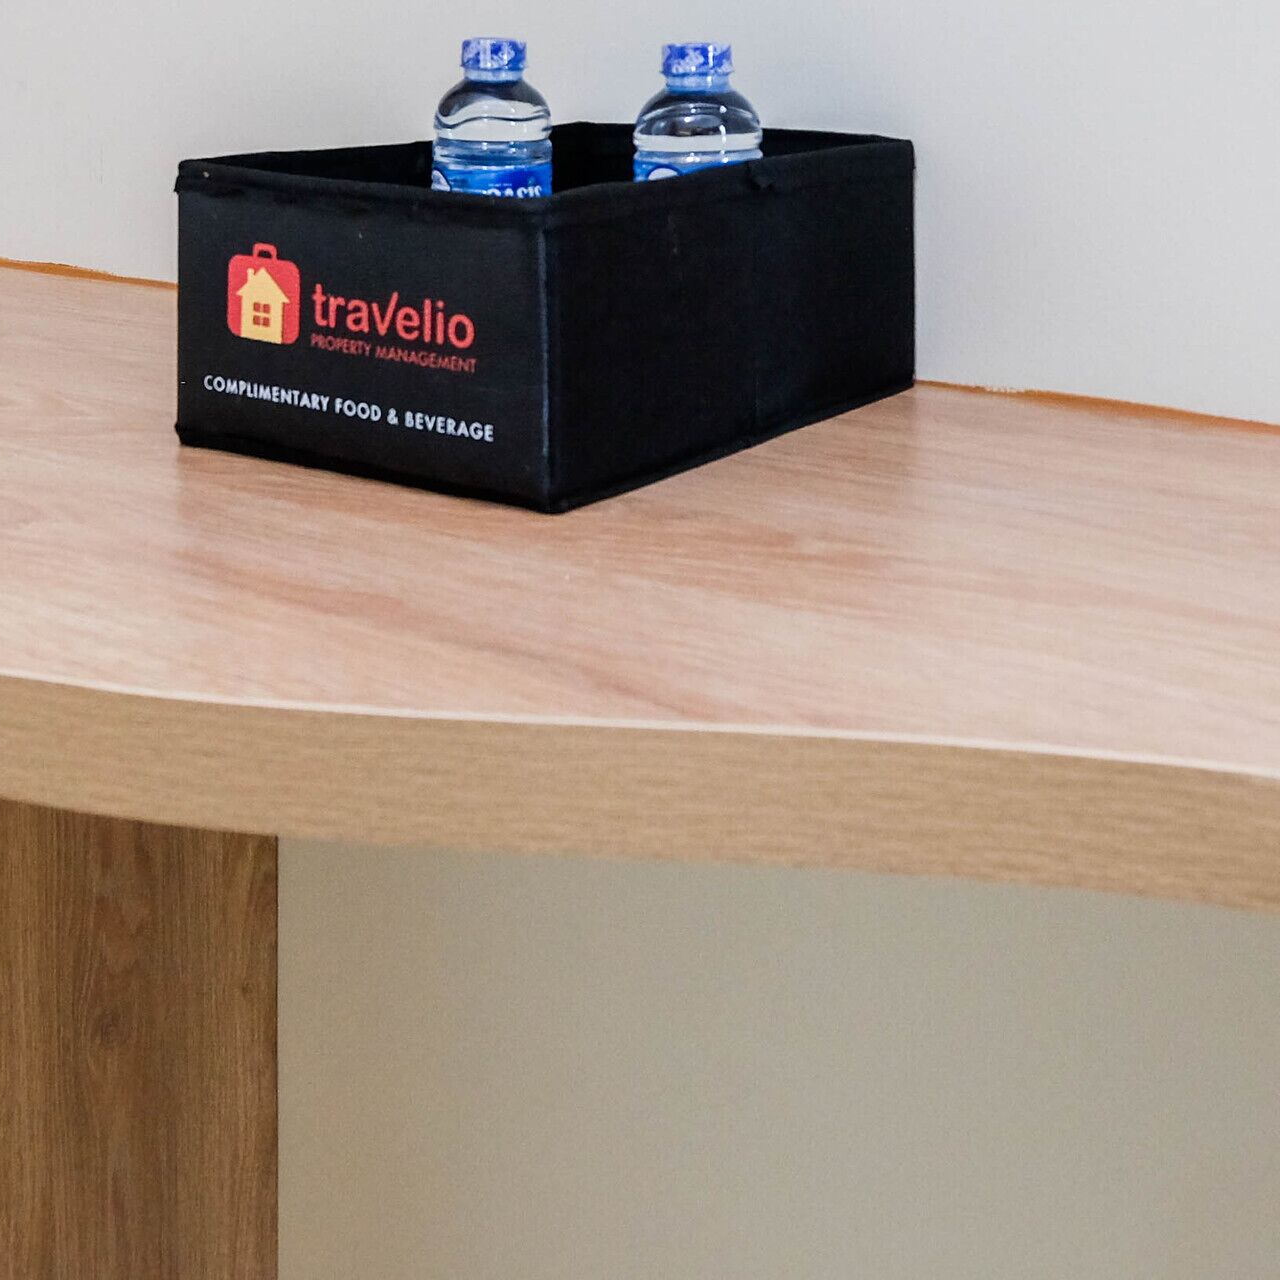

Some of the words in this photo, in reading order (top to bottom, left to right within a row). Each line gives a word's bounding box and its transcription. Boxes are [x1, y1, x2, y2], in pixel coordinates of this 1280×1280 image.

[312, 283, 475, 348] travelio
[310, 333, 371, 356] PROPERTY
[376, 345, 477, 373] MANAGEMENT
[204, 375, 330, 412] COMPLIMENTARY
[335, 398, 382, 421] FOOD
[386, 408, 399, 426] &
[405, 411, 494, 442] BEVERAGE
